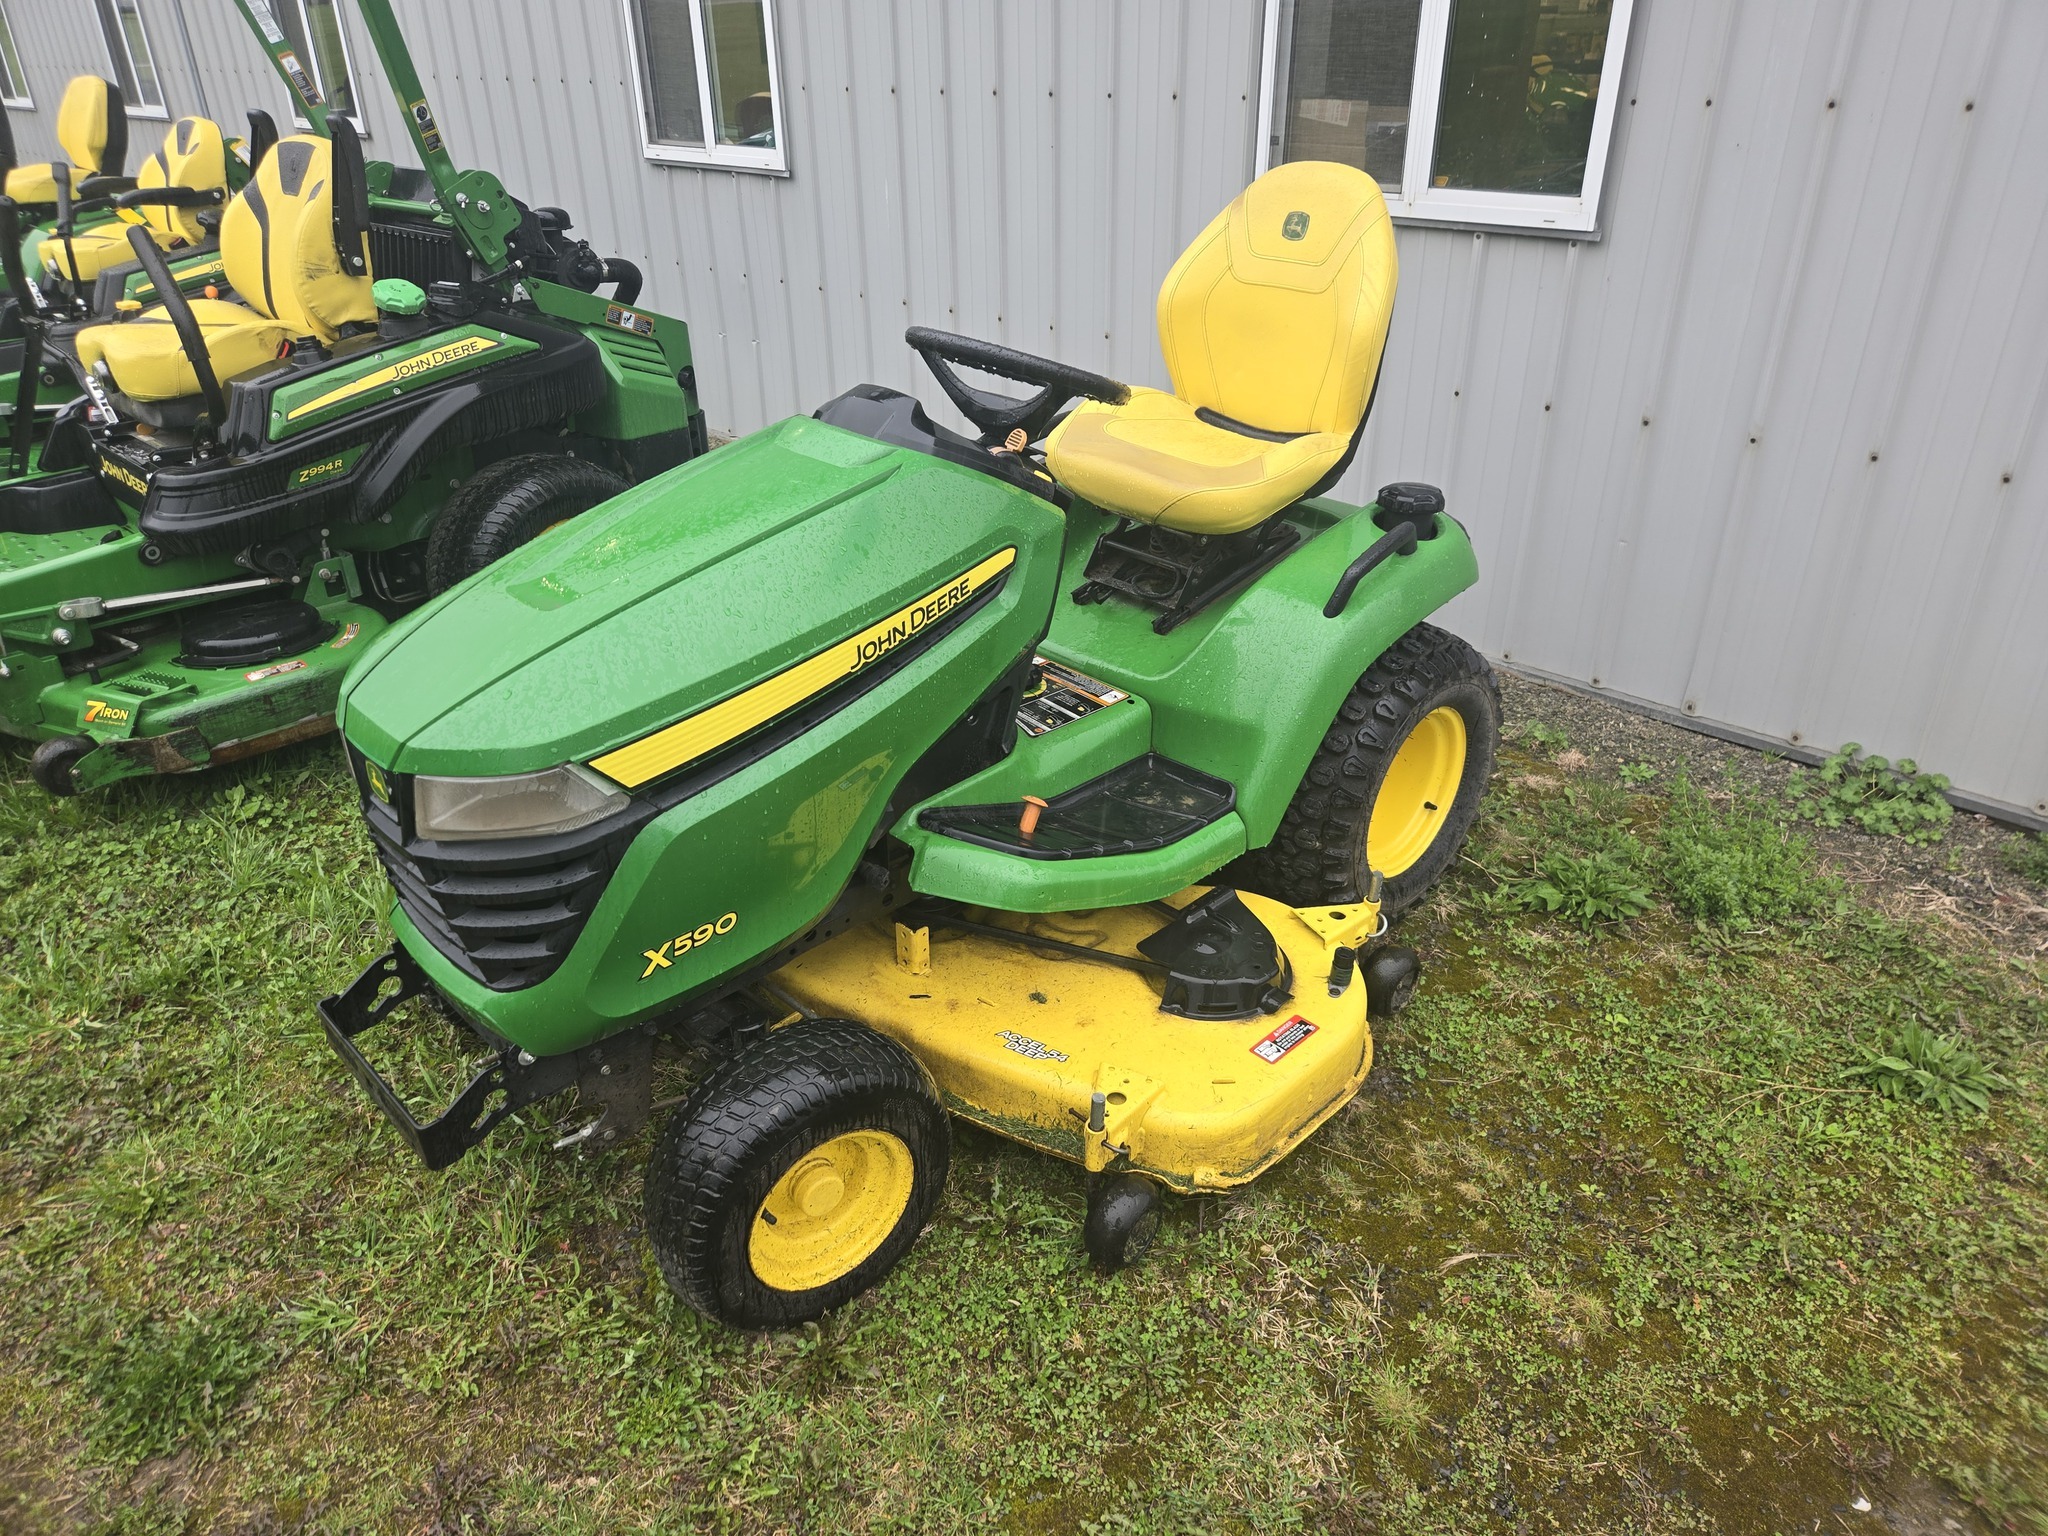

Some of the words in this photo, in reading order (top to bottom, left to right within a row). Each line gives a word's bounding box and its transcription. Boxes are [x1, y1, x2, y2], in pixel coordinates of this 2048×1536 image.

[393, 357, 431, 380] JOHN
[432, 341, 480, 365] DEERE
[101, 455, 126, 484] JOHN
[121, 467, 148, 496] DEER
[850, 621, 906, 671] JOHN
[910, 577, 971, 632] DEERE
[638, 911, 738, 981] X590
[995, 1030, 1047, 1054] ACCEL
[1003, 1041, 1048, 1060] DEEP
[1047, 1049, 1070, 1063] 54
